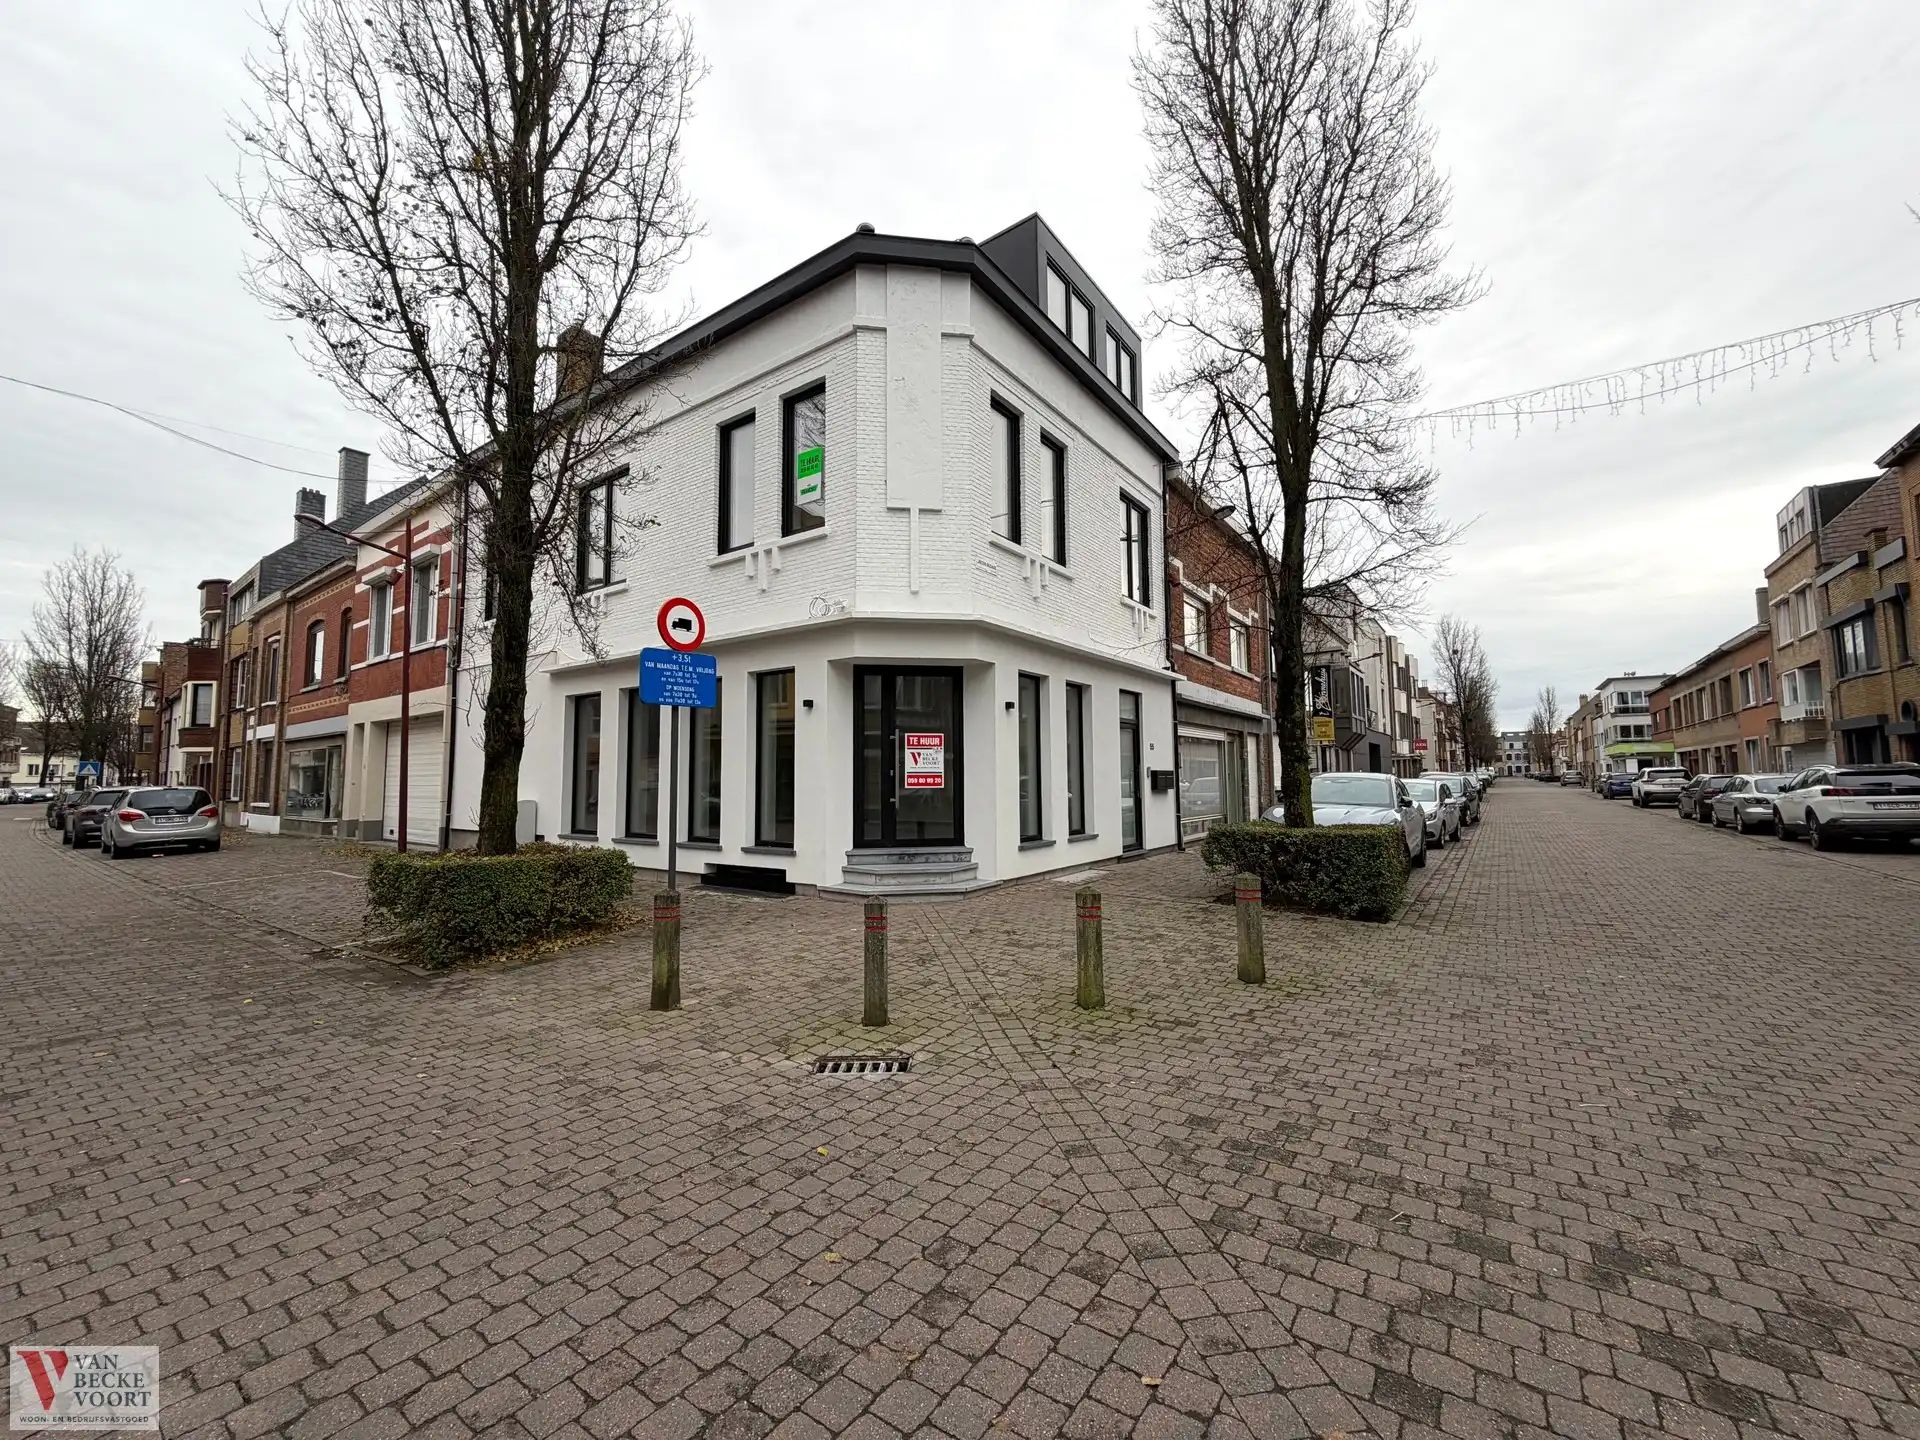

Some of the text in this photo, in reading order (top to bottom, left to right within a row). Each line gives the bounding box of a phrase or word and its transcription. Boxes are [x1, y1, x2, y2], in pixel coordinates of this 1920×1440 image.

[656, 662, 679, 670] MAANDAG
[909, 737, 940, 745] TE HUUR
